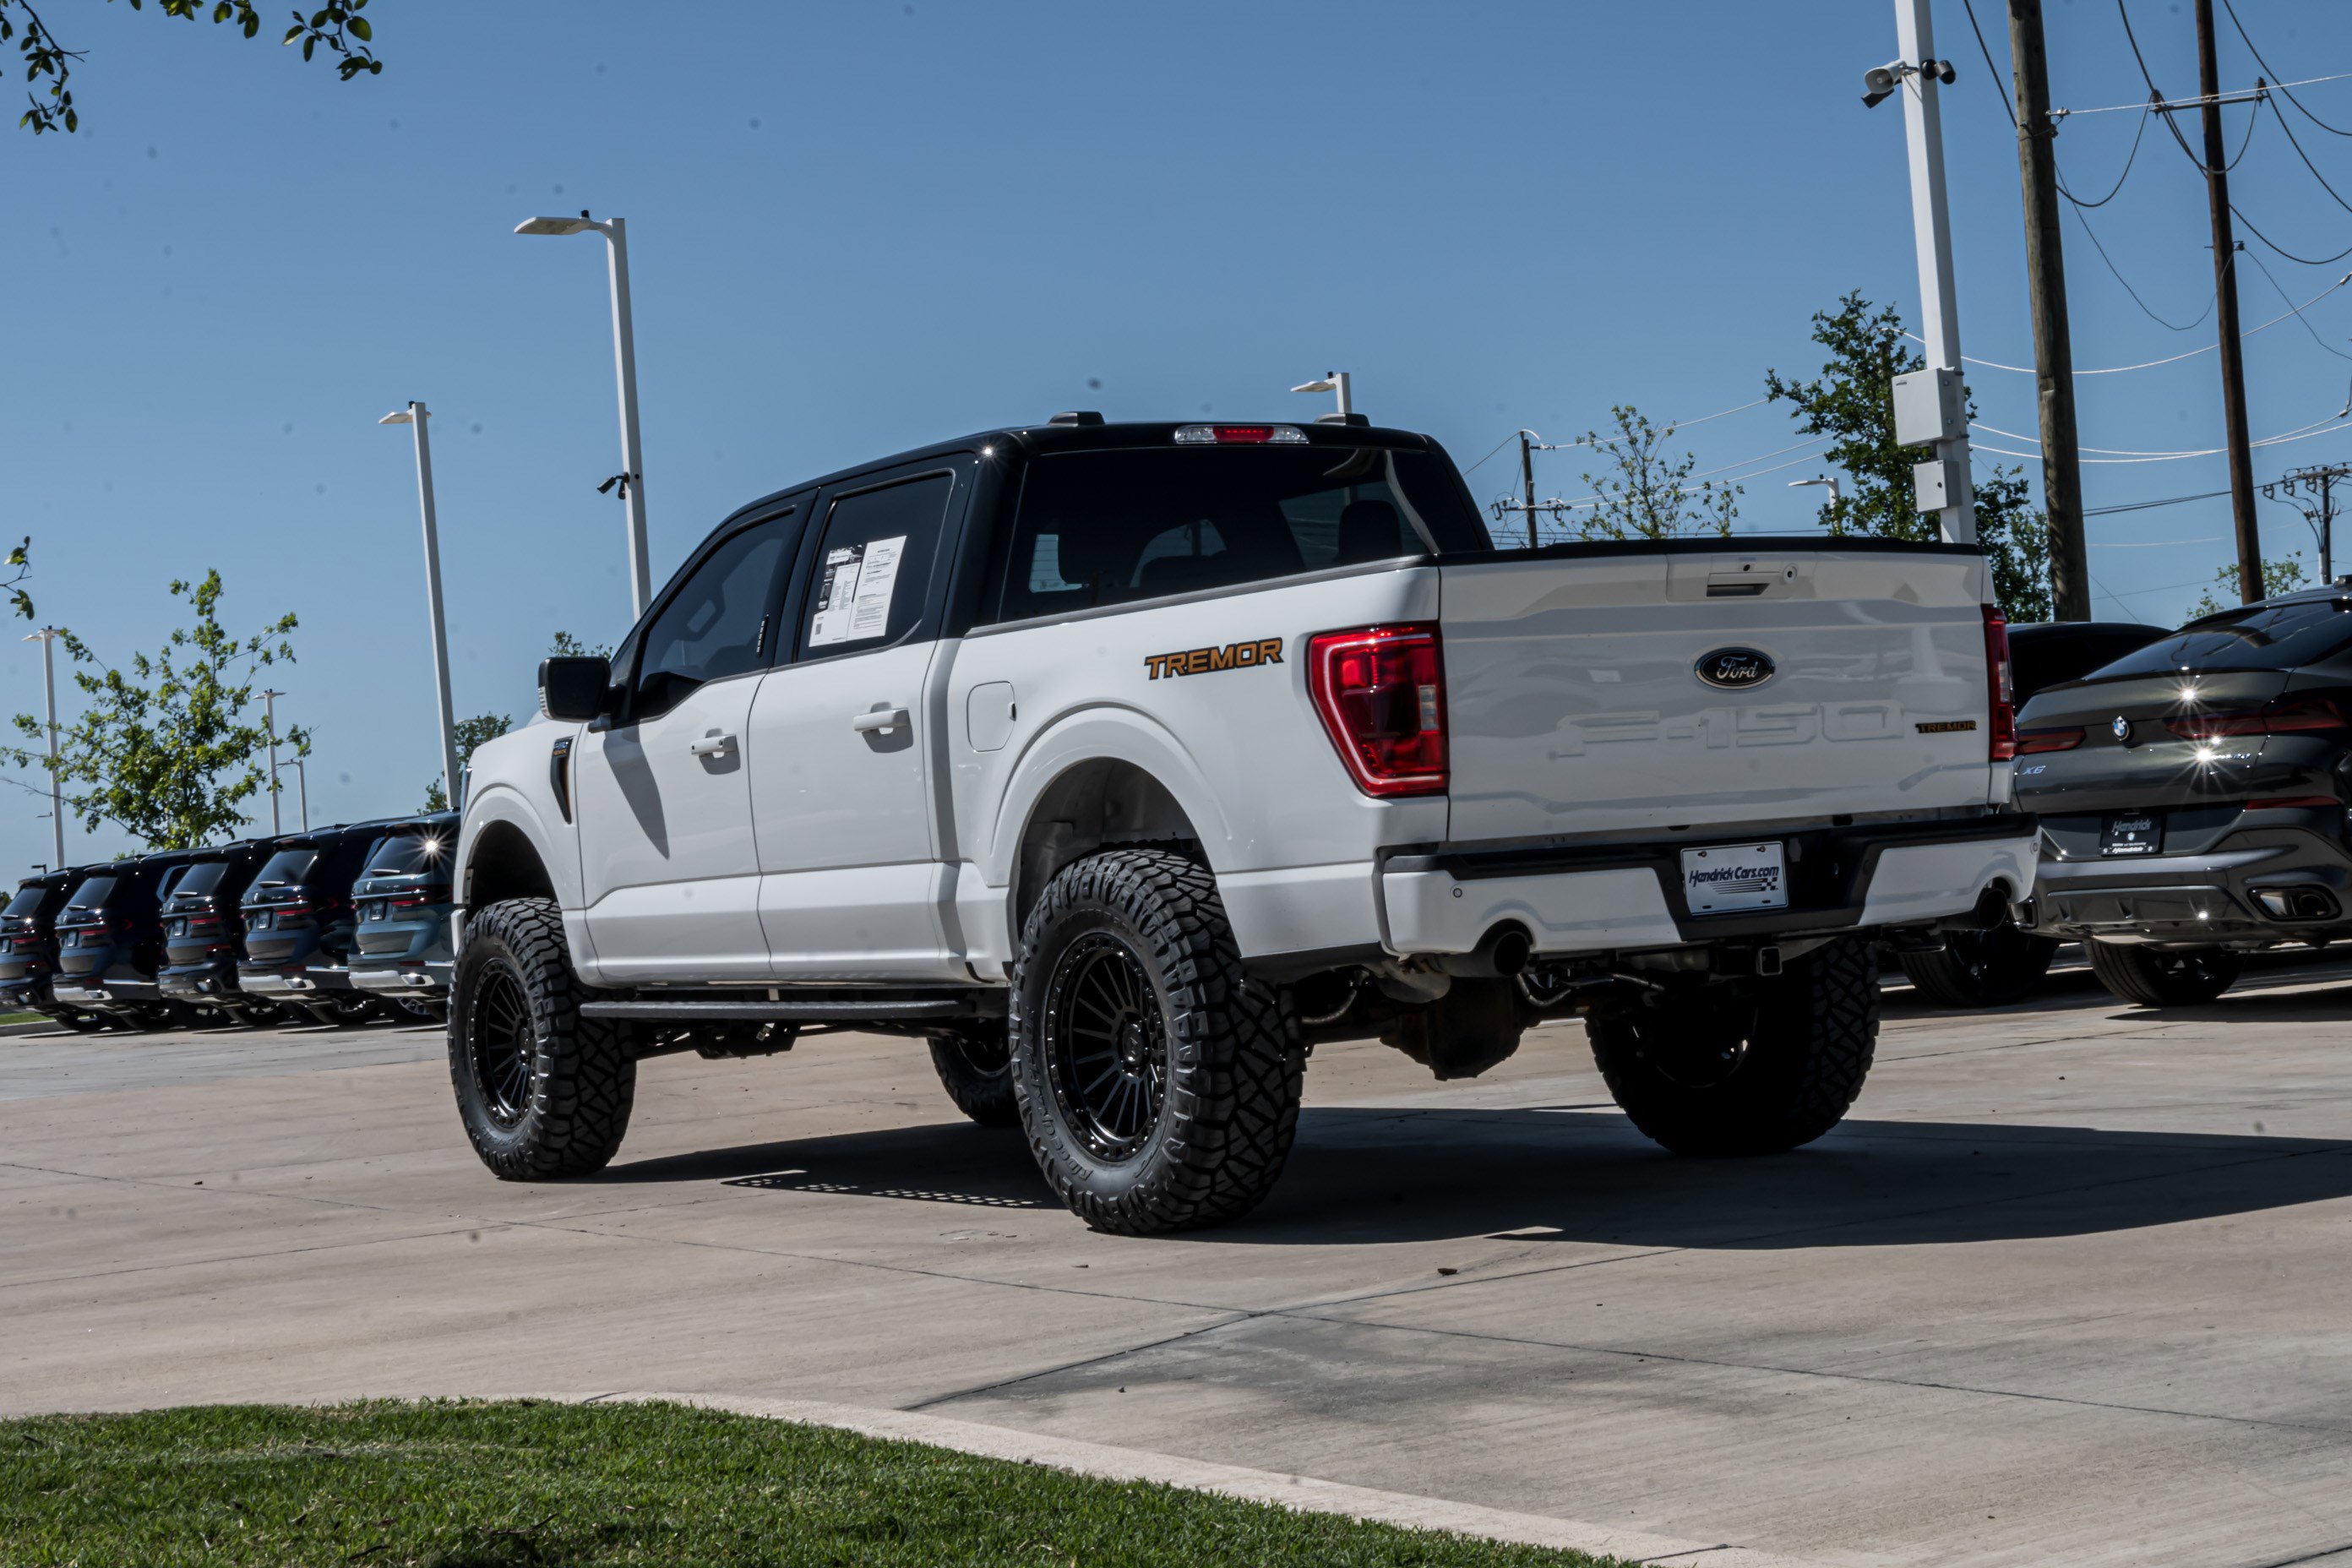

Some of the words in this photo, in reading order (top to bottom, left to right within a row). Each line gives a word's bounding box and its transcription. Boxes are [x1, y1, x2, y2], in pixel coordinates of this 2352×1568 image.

[1144, 636, 1284, 681] TREMOR
[1717, 656, 1758, 679] Ford
[1551, 699, 1905, 758] F-150
[1914, 720, 1977, 733] TREMOR
[2022, 765, 2046, 776] X6
